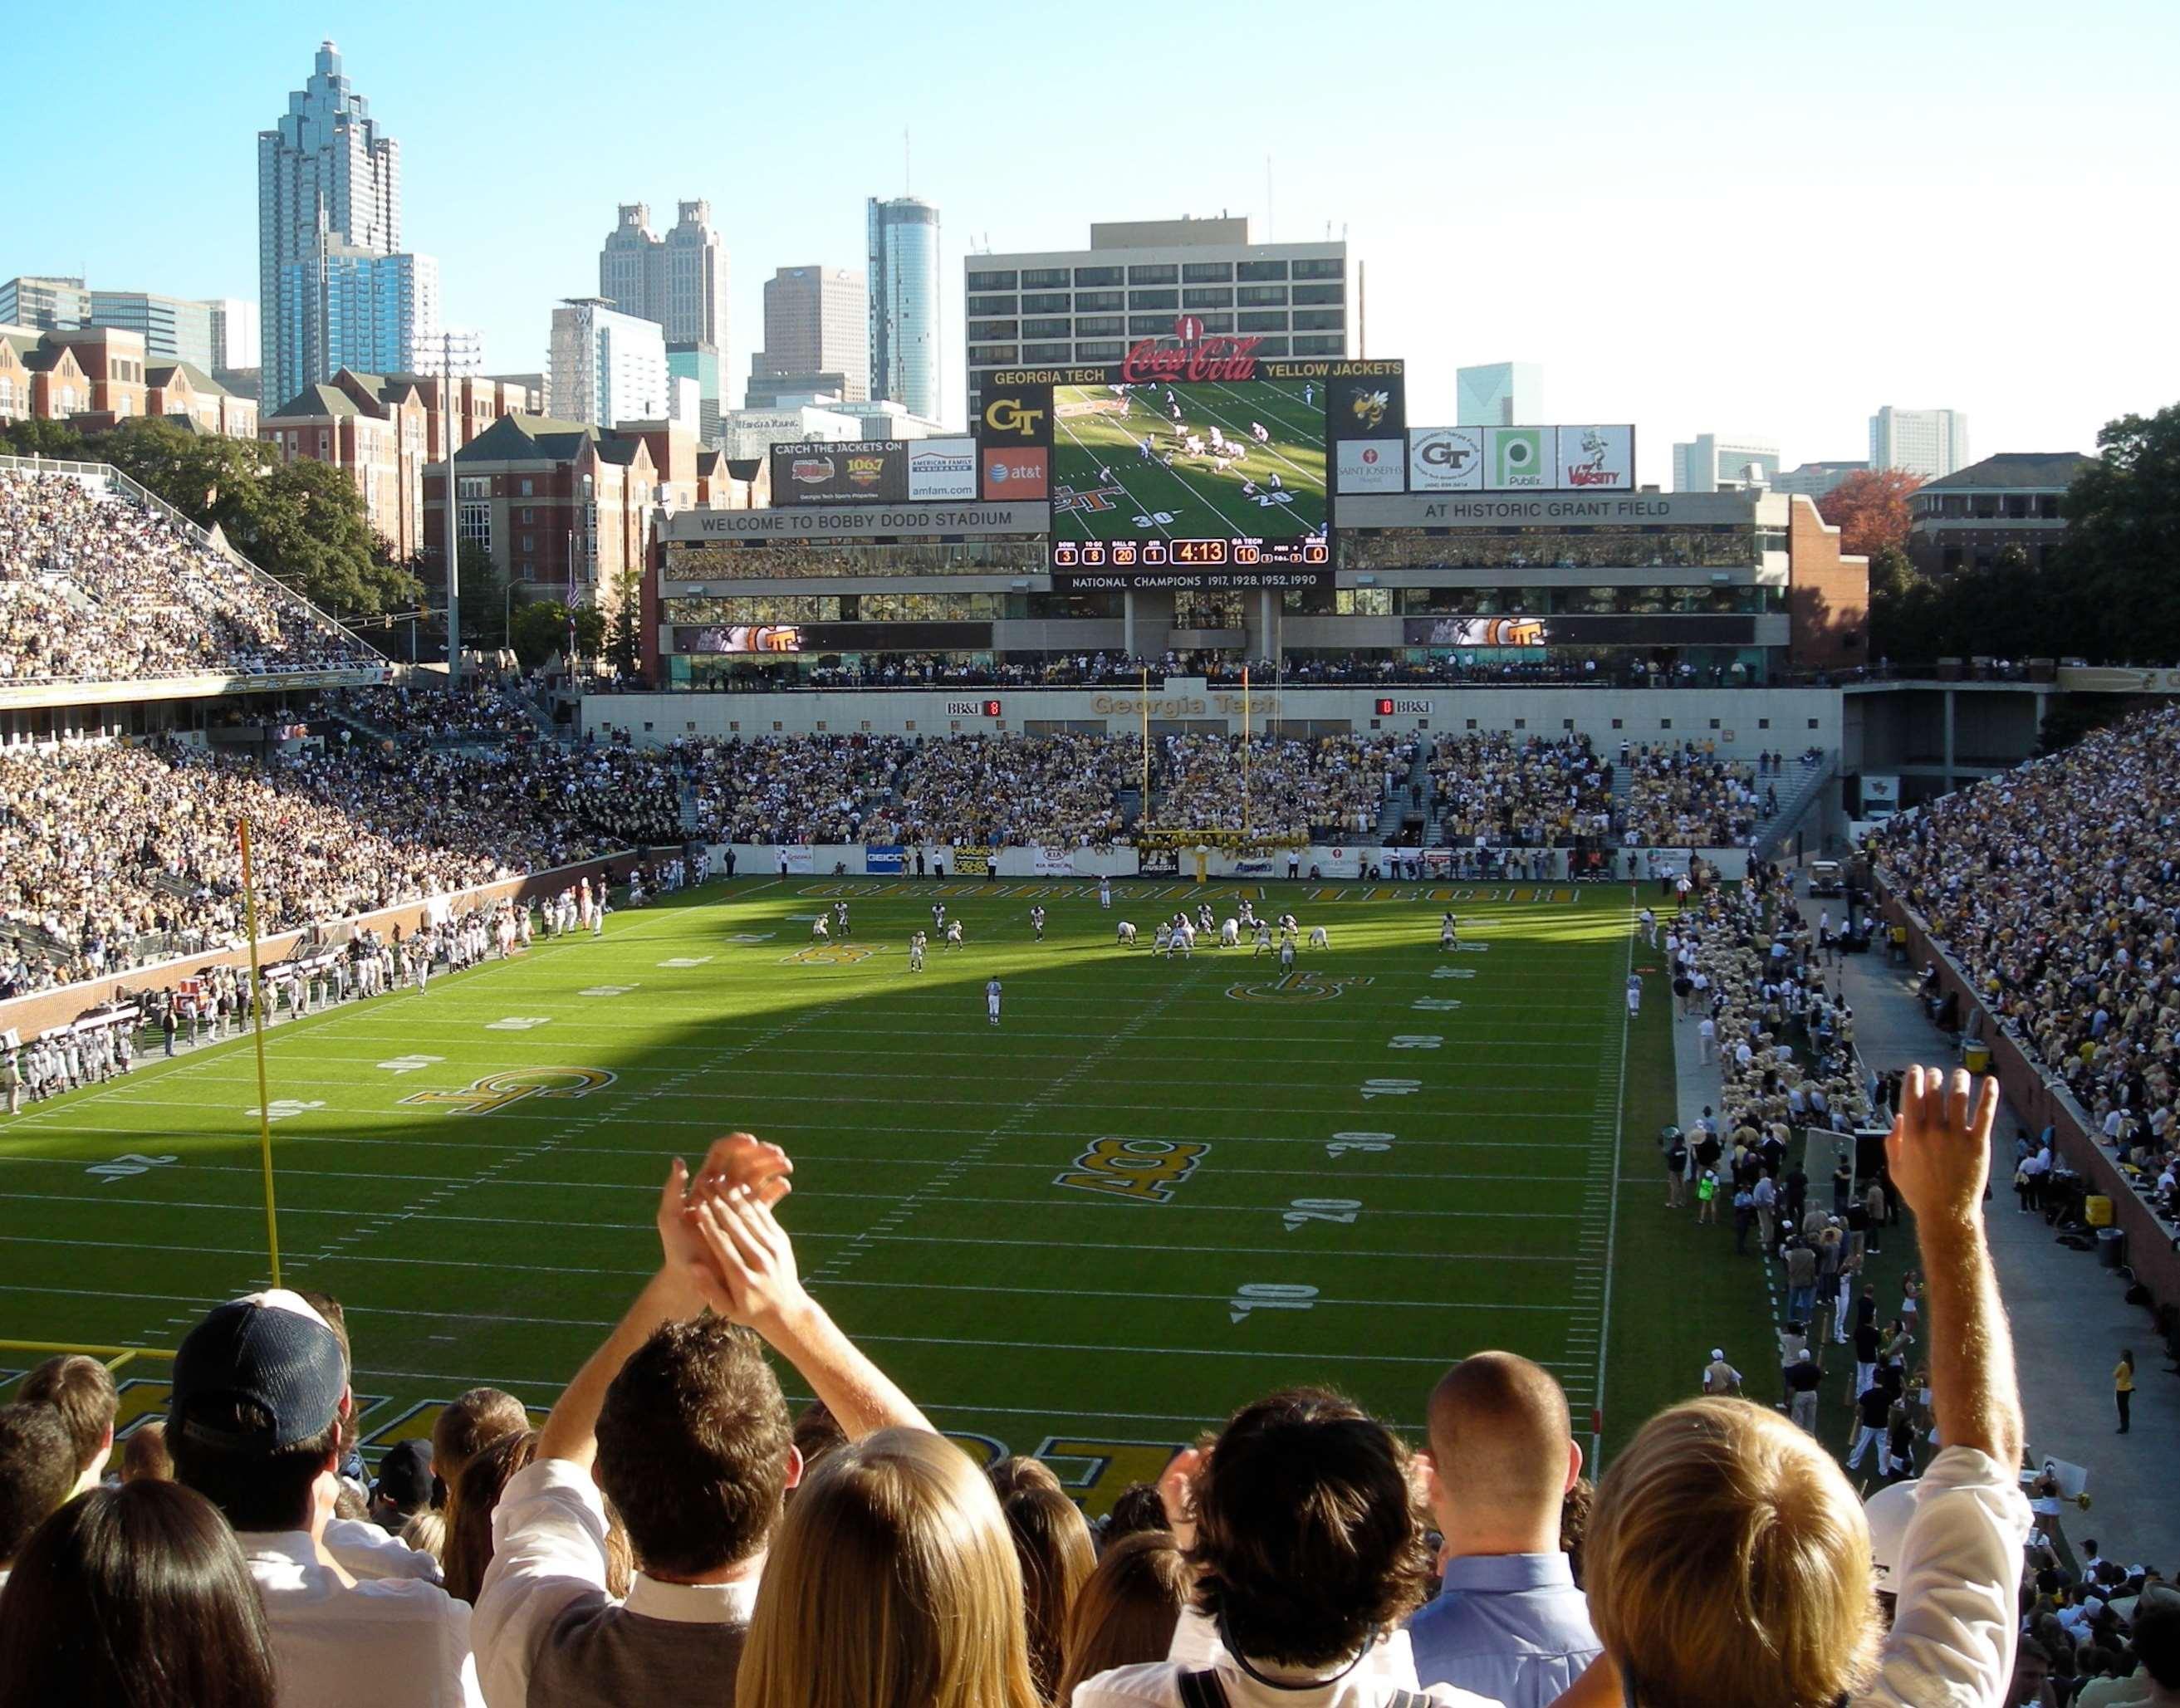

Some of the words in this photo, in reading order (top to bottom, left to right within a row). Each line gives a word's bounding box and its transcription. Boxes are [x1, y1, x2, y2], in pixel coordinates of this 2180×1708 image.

[994, 371, 1061, 384] GEORGIA
[1066, 369, 1105, 382] TECH
[1266, 363, 1329, 378] YELLOW
[1333, 362, 1403, 377] JACKETS
[986, 399, 1043, 435] GT
[775, 444, 810, 454] CATCH
[813, 443, 834, 453] THE
[837, 443, 882, 452] JACKETS
[885, 442, 902, 451] ON
[1422, 442, 1470, 469] GT
[1012, 465, 1041, 479] at&t
[1339, 466, 1364, 475] SAINT
[913, 486, 972, 496] amfam.com
[1425, 503, 1448, 517] AT
[1454, 502, 1541, 516] HISTORIC
[1548, 502, 1611, 516] GRANT
[1618, 501, 1669, 516] FIELD
[702, 516, 788, 532] WELCOME
[792, 516, 812, 530] TO
[818, 514, 874, 529] BOBBY
[881, 513, 929, 528] DODD
[935, 511, 1012, 526] STADIUM
[1063, 551, 1070, 561] 3
[1091, 551, 1099, 560] 8
[1118, 551, 1132, 561] 20
[1151, 551, 1157, 560] 1
[1181, 542, 1222, 561] 4:13
[1239, 549, 1257, 561] 10
[1313, 548, 1323, 560] 0
[1072, 577, 1127, 587] NATIONAL
[1134, 576, 1201, 587] CHAMPIONS
[1291, 575, 1316, 585] 1990
[1092, 694, 1206, 718] Georgia
[1214, 694, 1280, 714] Tech
[1141, 864, 1177, 872] RUSSELL
[1325, 1132, 1396, 1153] 30
[86, 1153, 178, 1176] 20
[1282, 1198, 1363, 1223] 20
[1230, 1284, 1320, 1309] 10
